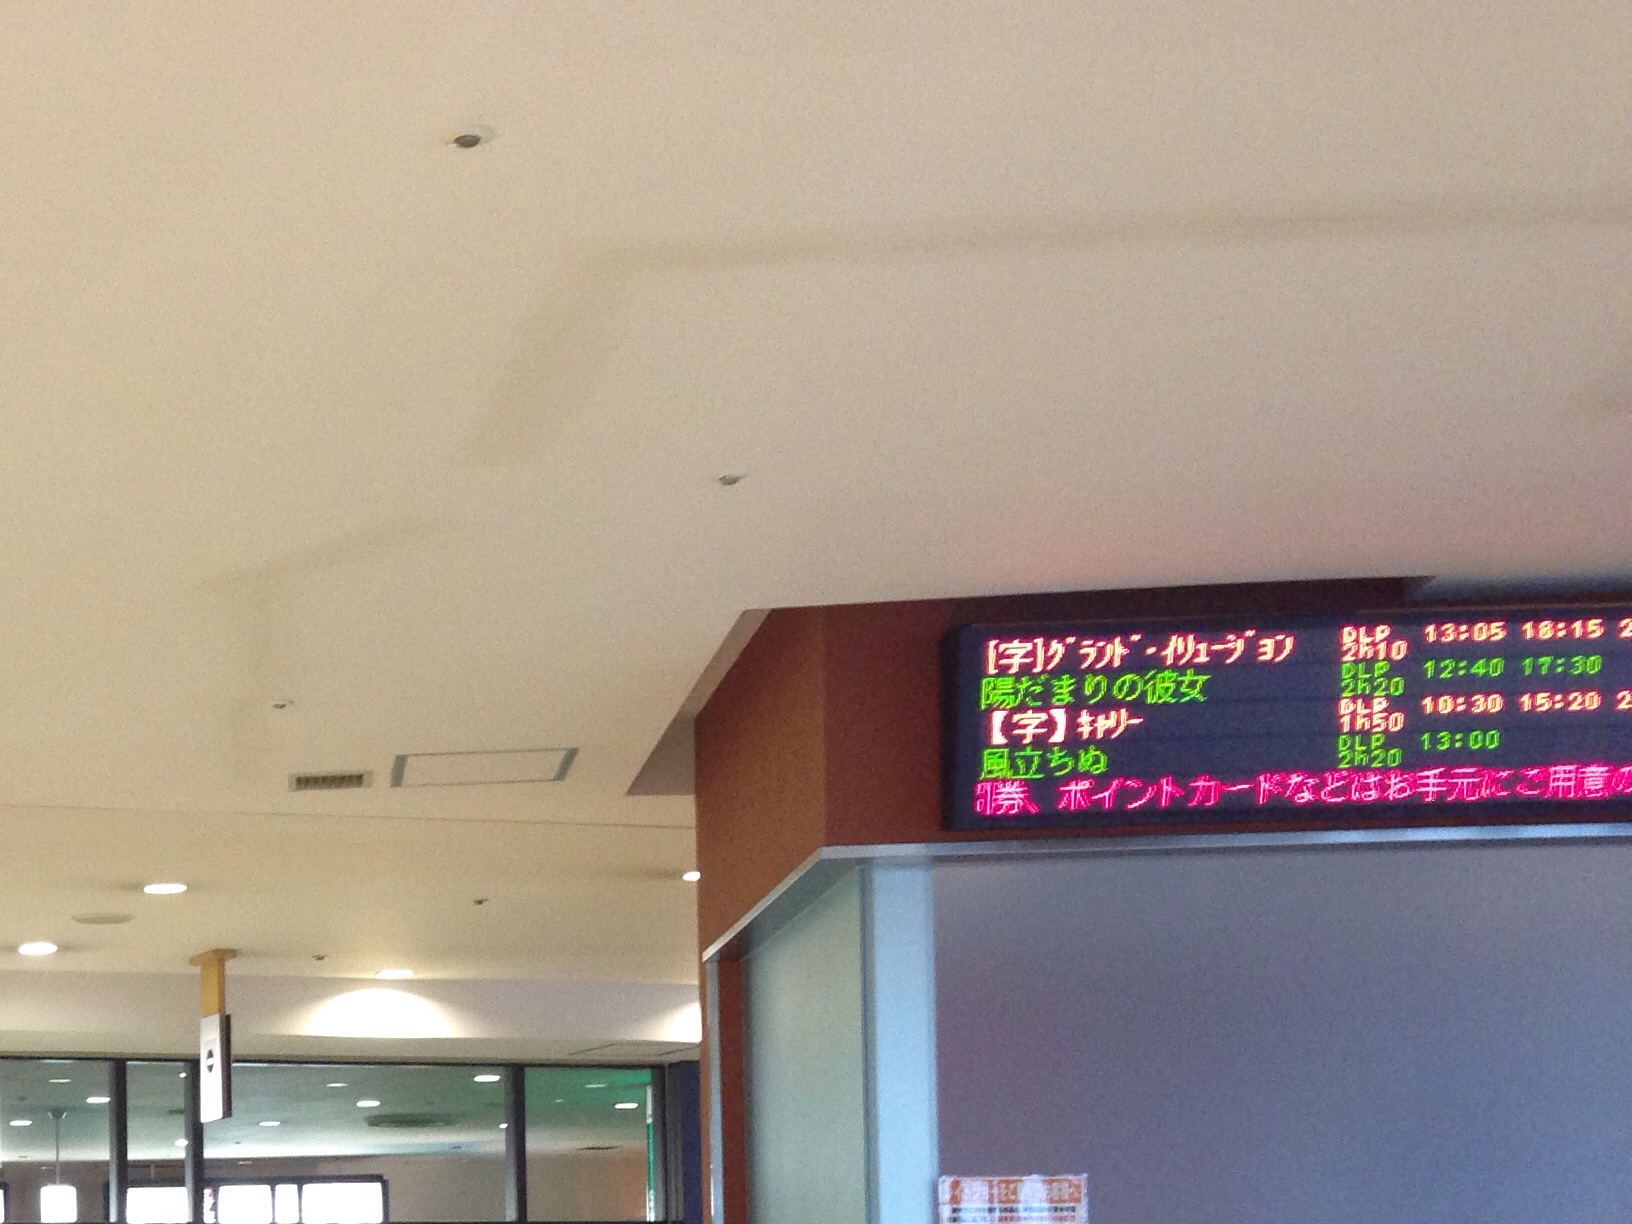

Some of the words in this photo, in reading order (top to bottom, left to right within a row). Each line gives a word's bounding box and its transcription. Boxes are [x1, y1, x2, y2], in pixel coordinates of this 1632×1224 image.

[1341, 625, 1391, 643] DLP
[1424, 621, 1507, 643] 13:05
[1522, 619, 1605, 640] 18:15
[1342, 641, 1407, 661] 2h10
[1341, 660, 1390, 678] DLP
[1423, 657, 1505, 679] 12:40
[1522, 655, 1602, 675] 17:30
[980, 668, 1211, 710] 陽だまりの彼女
[1341, 677, 1405, 697] 2h20
[1339, 696, 1388, 714] DLP
[1422, 693, 1504, 714] 10:30
[1520, 691, 1601, 712] 15:20
[1340, 713, 1405, 732] 1h50
[1337, 733, 1386, 751] DLP
[1421, 730, 1501, 751] 13:00
[980, 745, 1109, 780] 風立ちぬ
[1337, 749, 1402, 768] 2h20
